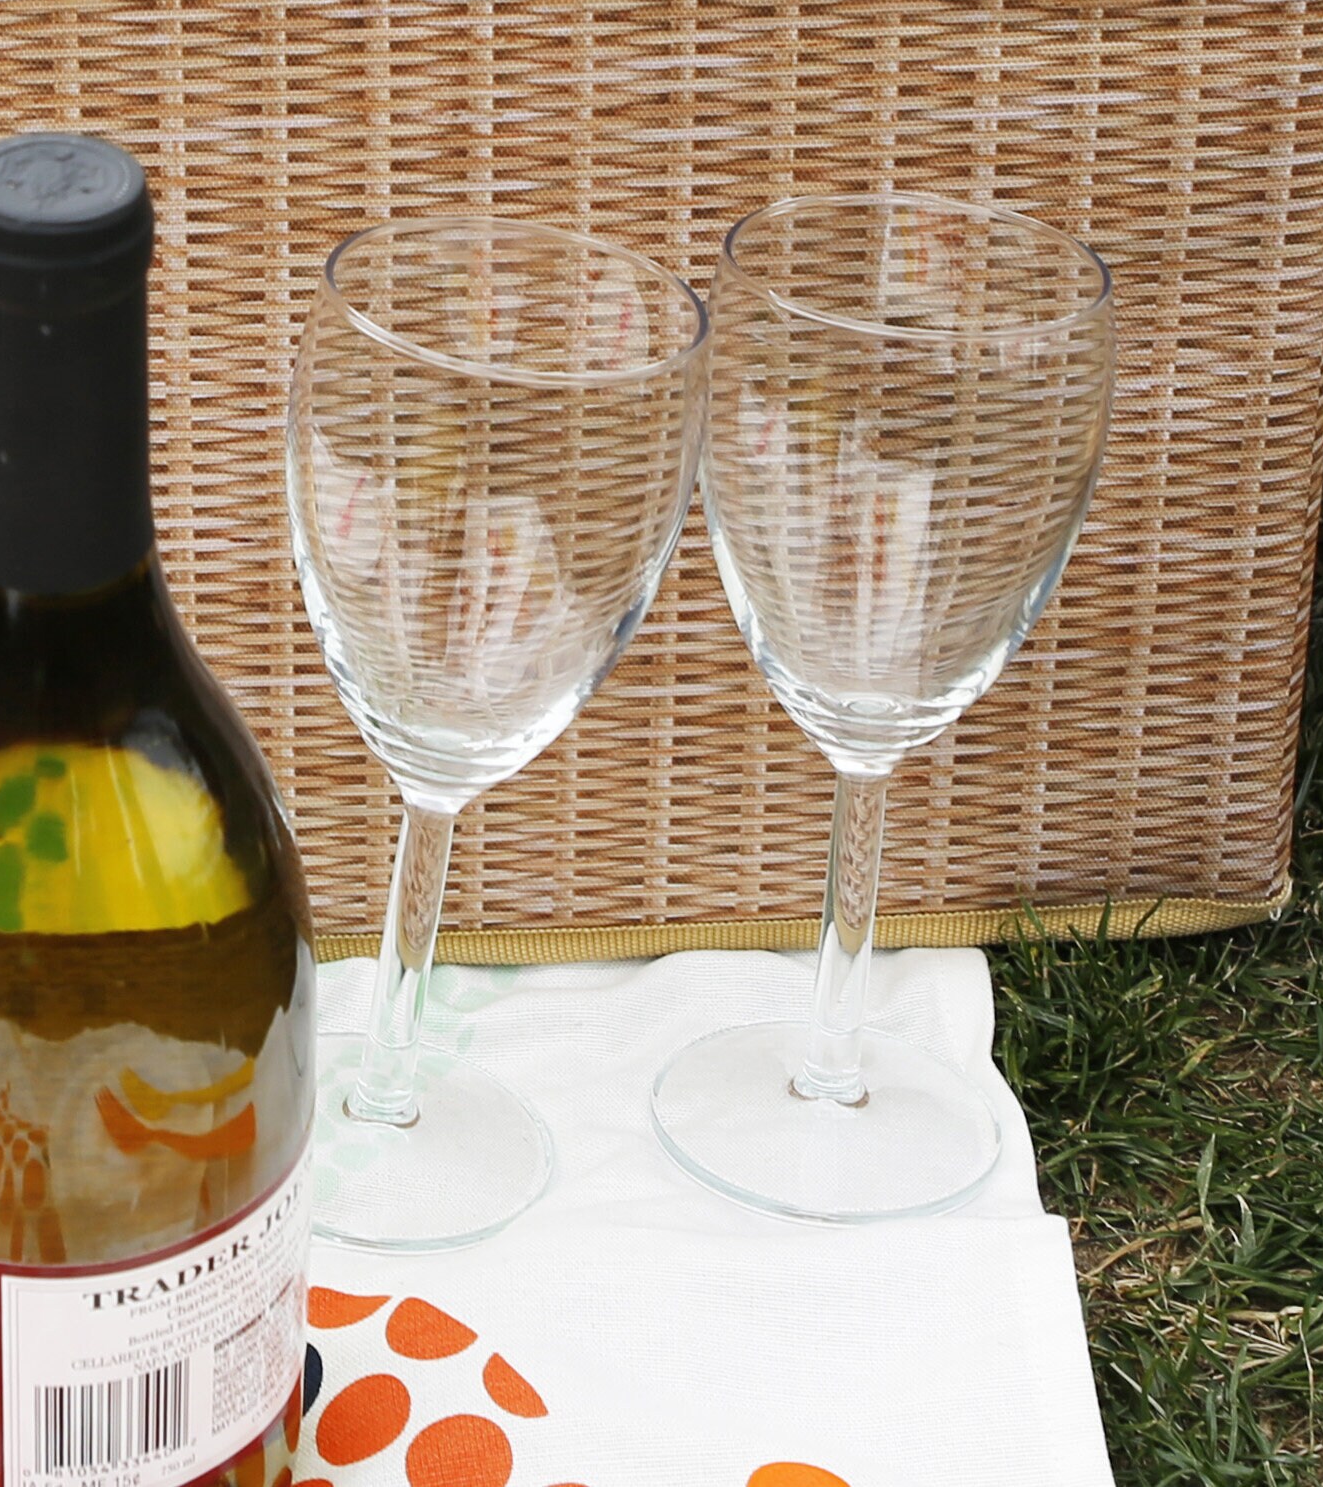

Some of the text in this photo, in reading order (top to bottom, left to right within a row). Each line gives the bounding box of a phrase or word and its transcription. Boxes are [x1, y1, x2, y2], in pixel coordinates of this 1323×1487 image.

[83, 1235, 250, 1309] TRADER
[130, 1297, 171, 1318] FROM
[176, 1268, 229, 1303] BRONCO
[166, 1288, 218, 1321] Charles
[222, 1264, 253, 1295] Shaw
[70, 1346, 142, 1370] CELLARED
[162, 1315, 217, 1350] BOTTLED
[128, 1323, 172, 1347] Bottled
[177, 1291, 237, 1330] Exclusively
[133, 1353, 167, 1373] NAPA
[172, 1341, 196, 1359] AND
